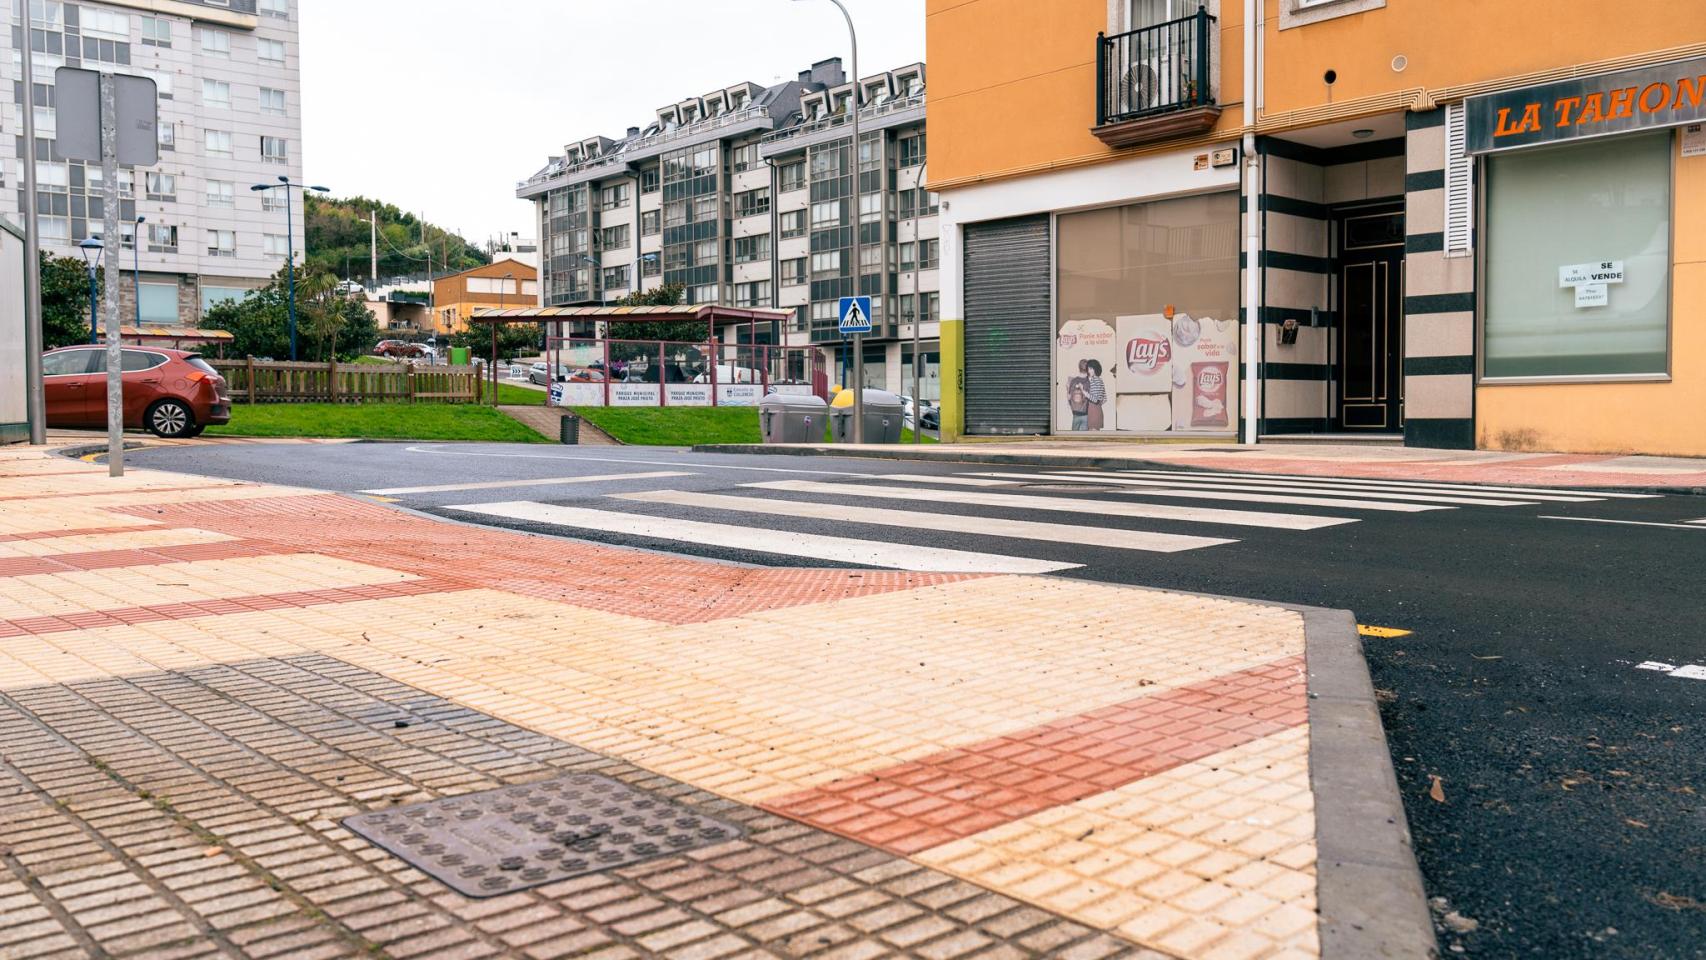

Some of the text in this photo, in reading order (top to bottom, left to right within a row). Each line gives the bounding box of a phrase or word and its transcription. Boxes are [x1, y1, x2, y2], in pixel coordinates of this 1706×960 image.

[1493, 103, 1542, 137] LA
[1591, 272, 1623, 280] VENDE
[1129, 337, 1169, 369] Lay's
[1200, 372, 1221, 385] Lay's
